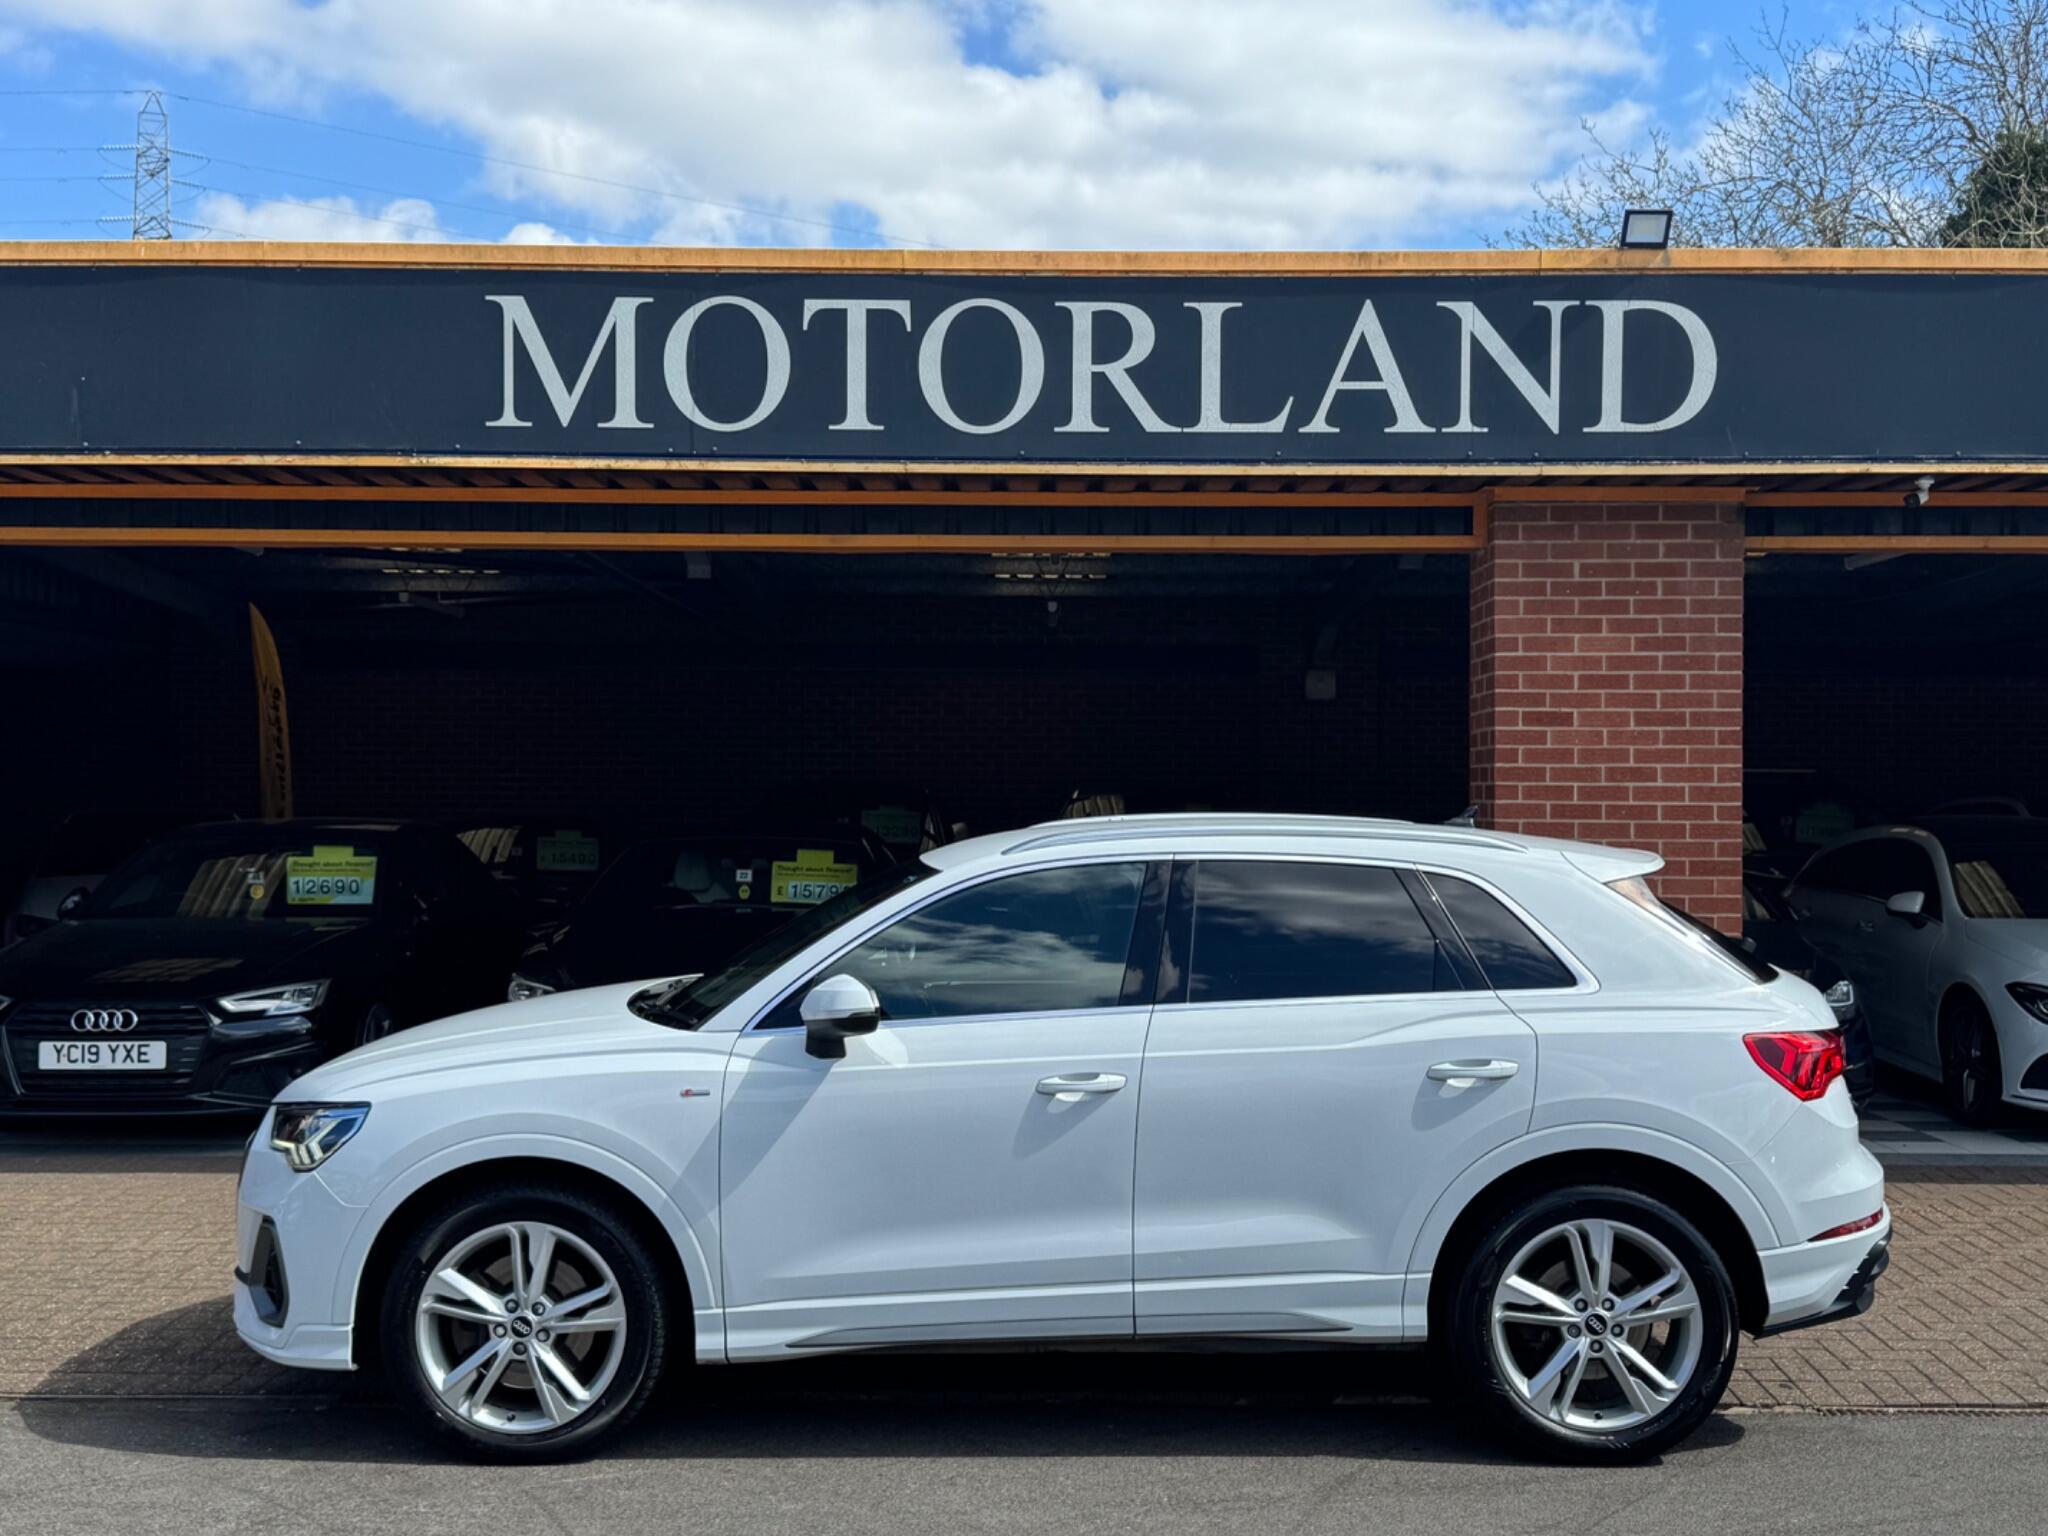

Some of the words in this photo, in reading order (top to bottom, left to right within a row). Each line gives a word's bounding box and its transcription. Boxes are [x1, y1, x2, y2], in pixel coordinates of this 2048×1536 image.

[484, 294, 1718, 435] MOTORLAND
[293, 879, 360, 895] 12690
[791, 884, 849, 898] 1579
[53, 1044, 100, 1063] YC19
[108, 1044, 151, 1063] YXE
